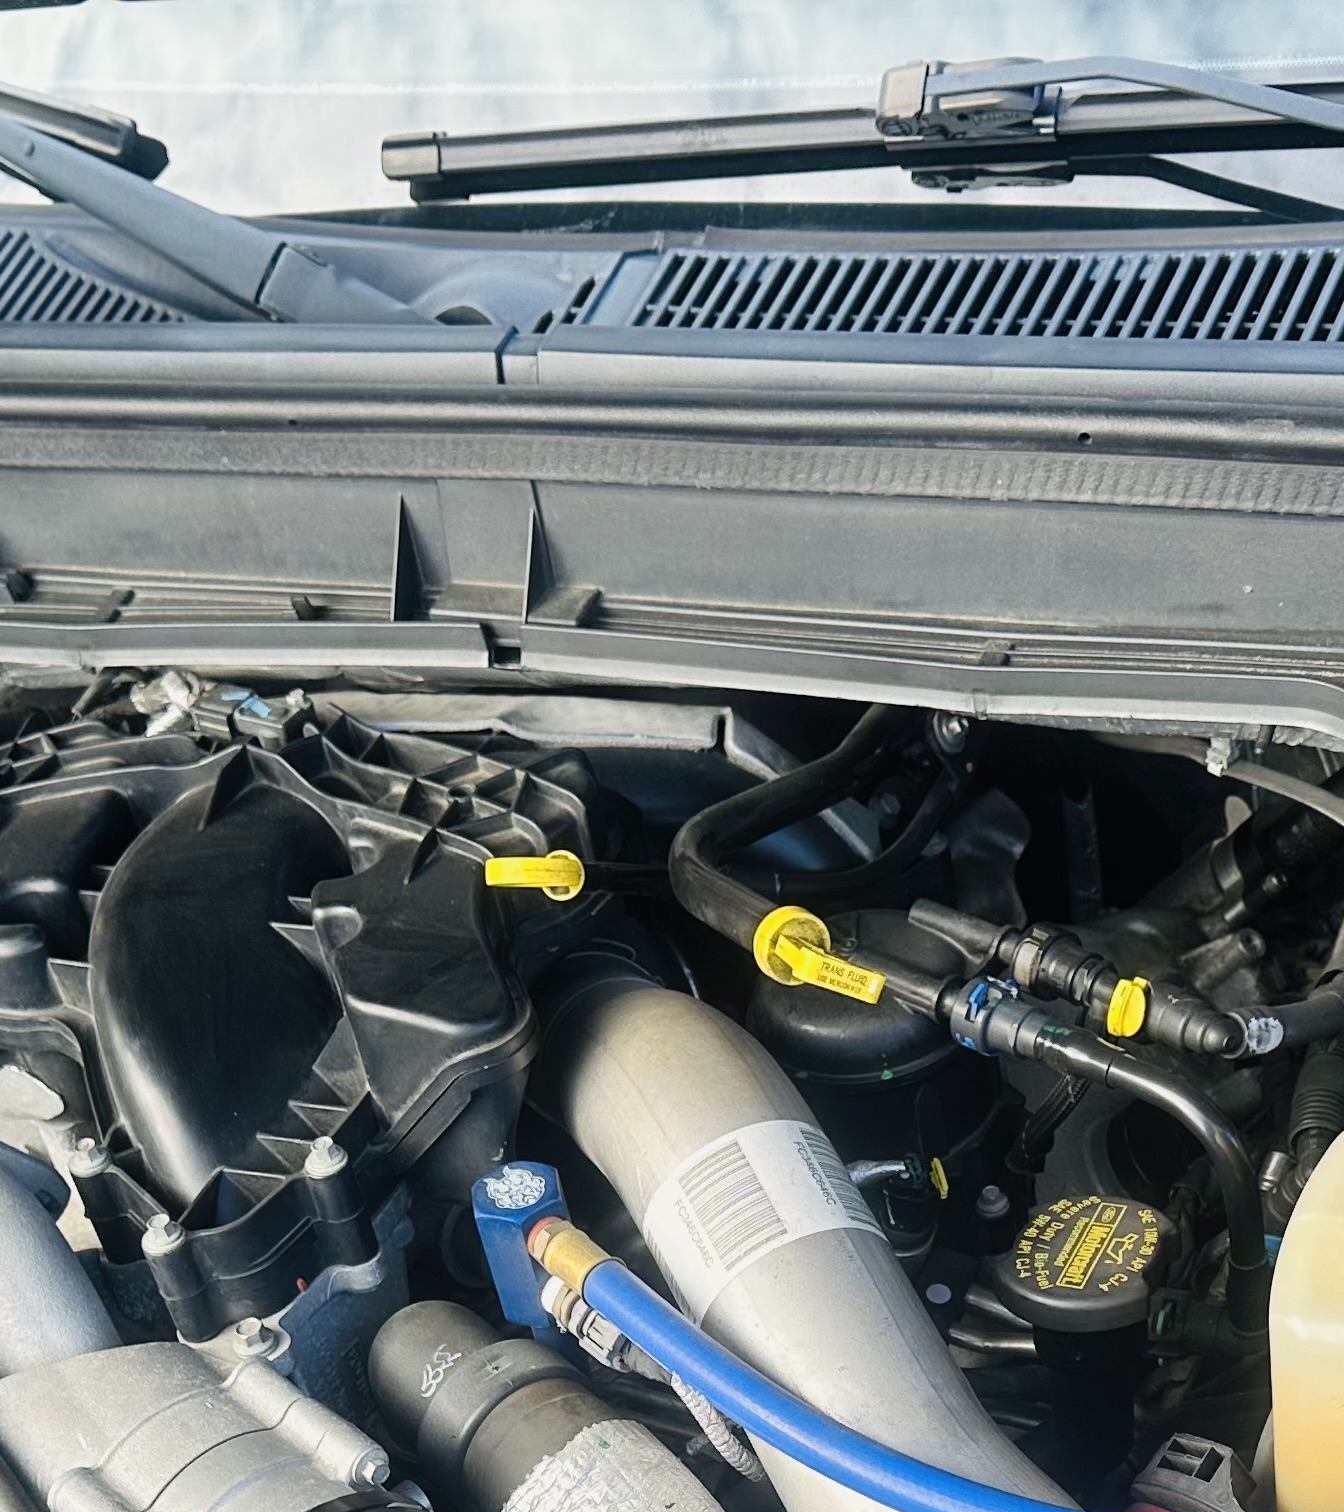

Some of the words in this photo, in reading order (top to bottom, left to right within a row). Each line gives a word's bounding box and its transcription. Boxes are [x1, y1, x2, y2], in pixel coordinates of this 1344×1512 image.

[821, 962, 845, 977] TRANS
[847, 971, 868, 987] FLUID
[1048, 1199, 1072, 1214] SAE
[1059, 1195, 1101, 1220] Severe
[1137, 1209, 1157, 1224] SAE
[1039, 1221, 1065, 1242] Duty
[1016, 1239, 1033, 1254] API
[1062, 1225, 1111, 1285] Motorcraft
[1015, 1257, 1032, 1279] CJ-4
[1033, 1252, 1054, 1290] Bio-Fuel
[1126, 1256, 1148, 1273] API
[1098, 1273, 1128, 1292] CJ-4
